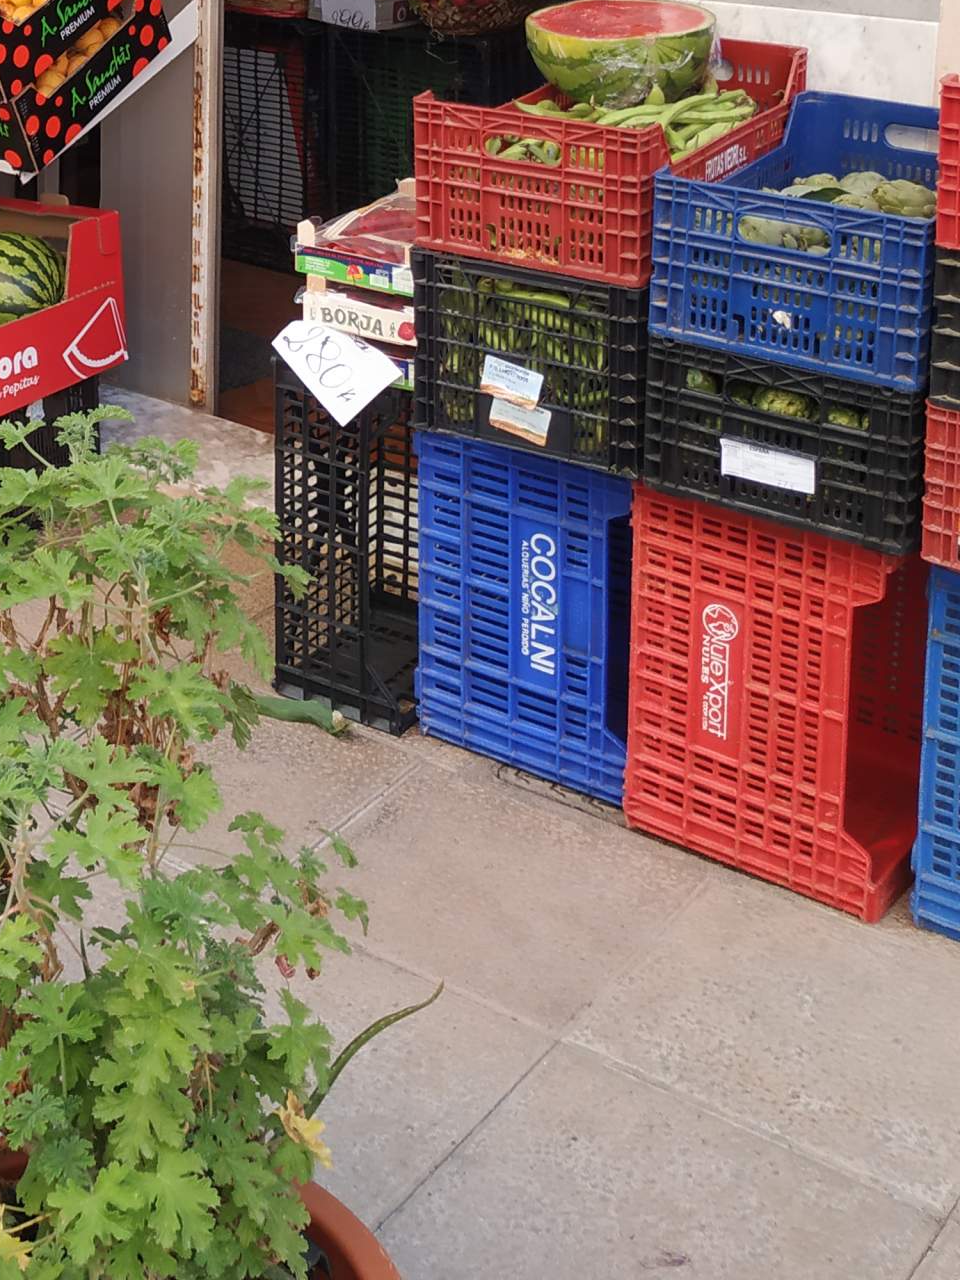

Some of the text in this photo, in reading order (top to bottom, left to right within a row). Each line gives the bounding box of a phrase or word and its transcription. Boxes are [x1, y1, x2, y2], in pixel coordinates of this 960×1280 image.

[60, 5, 96, 40] PREMIUM
[89, 75, 122, 110] PREMIUM
[320, 307, 384, 337] BORJA
[521, 539, 530, 656] ALQUERIAS NIÑO PERDIDO
[529, 533, 556, 675] COCALNI
[701, 634, 711, 684] NULES
